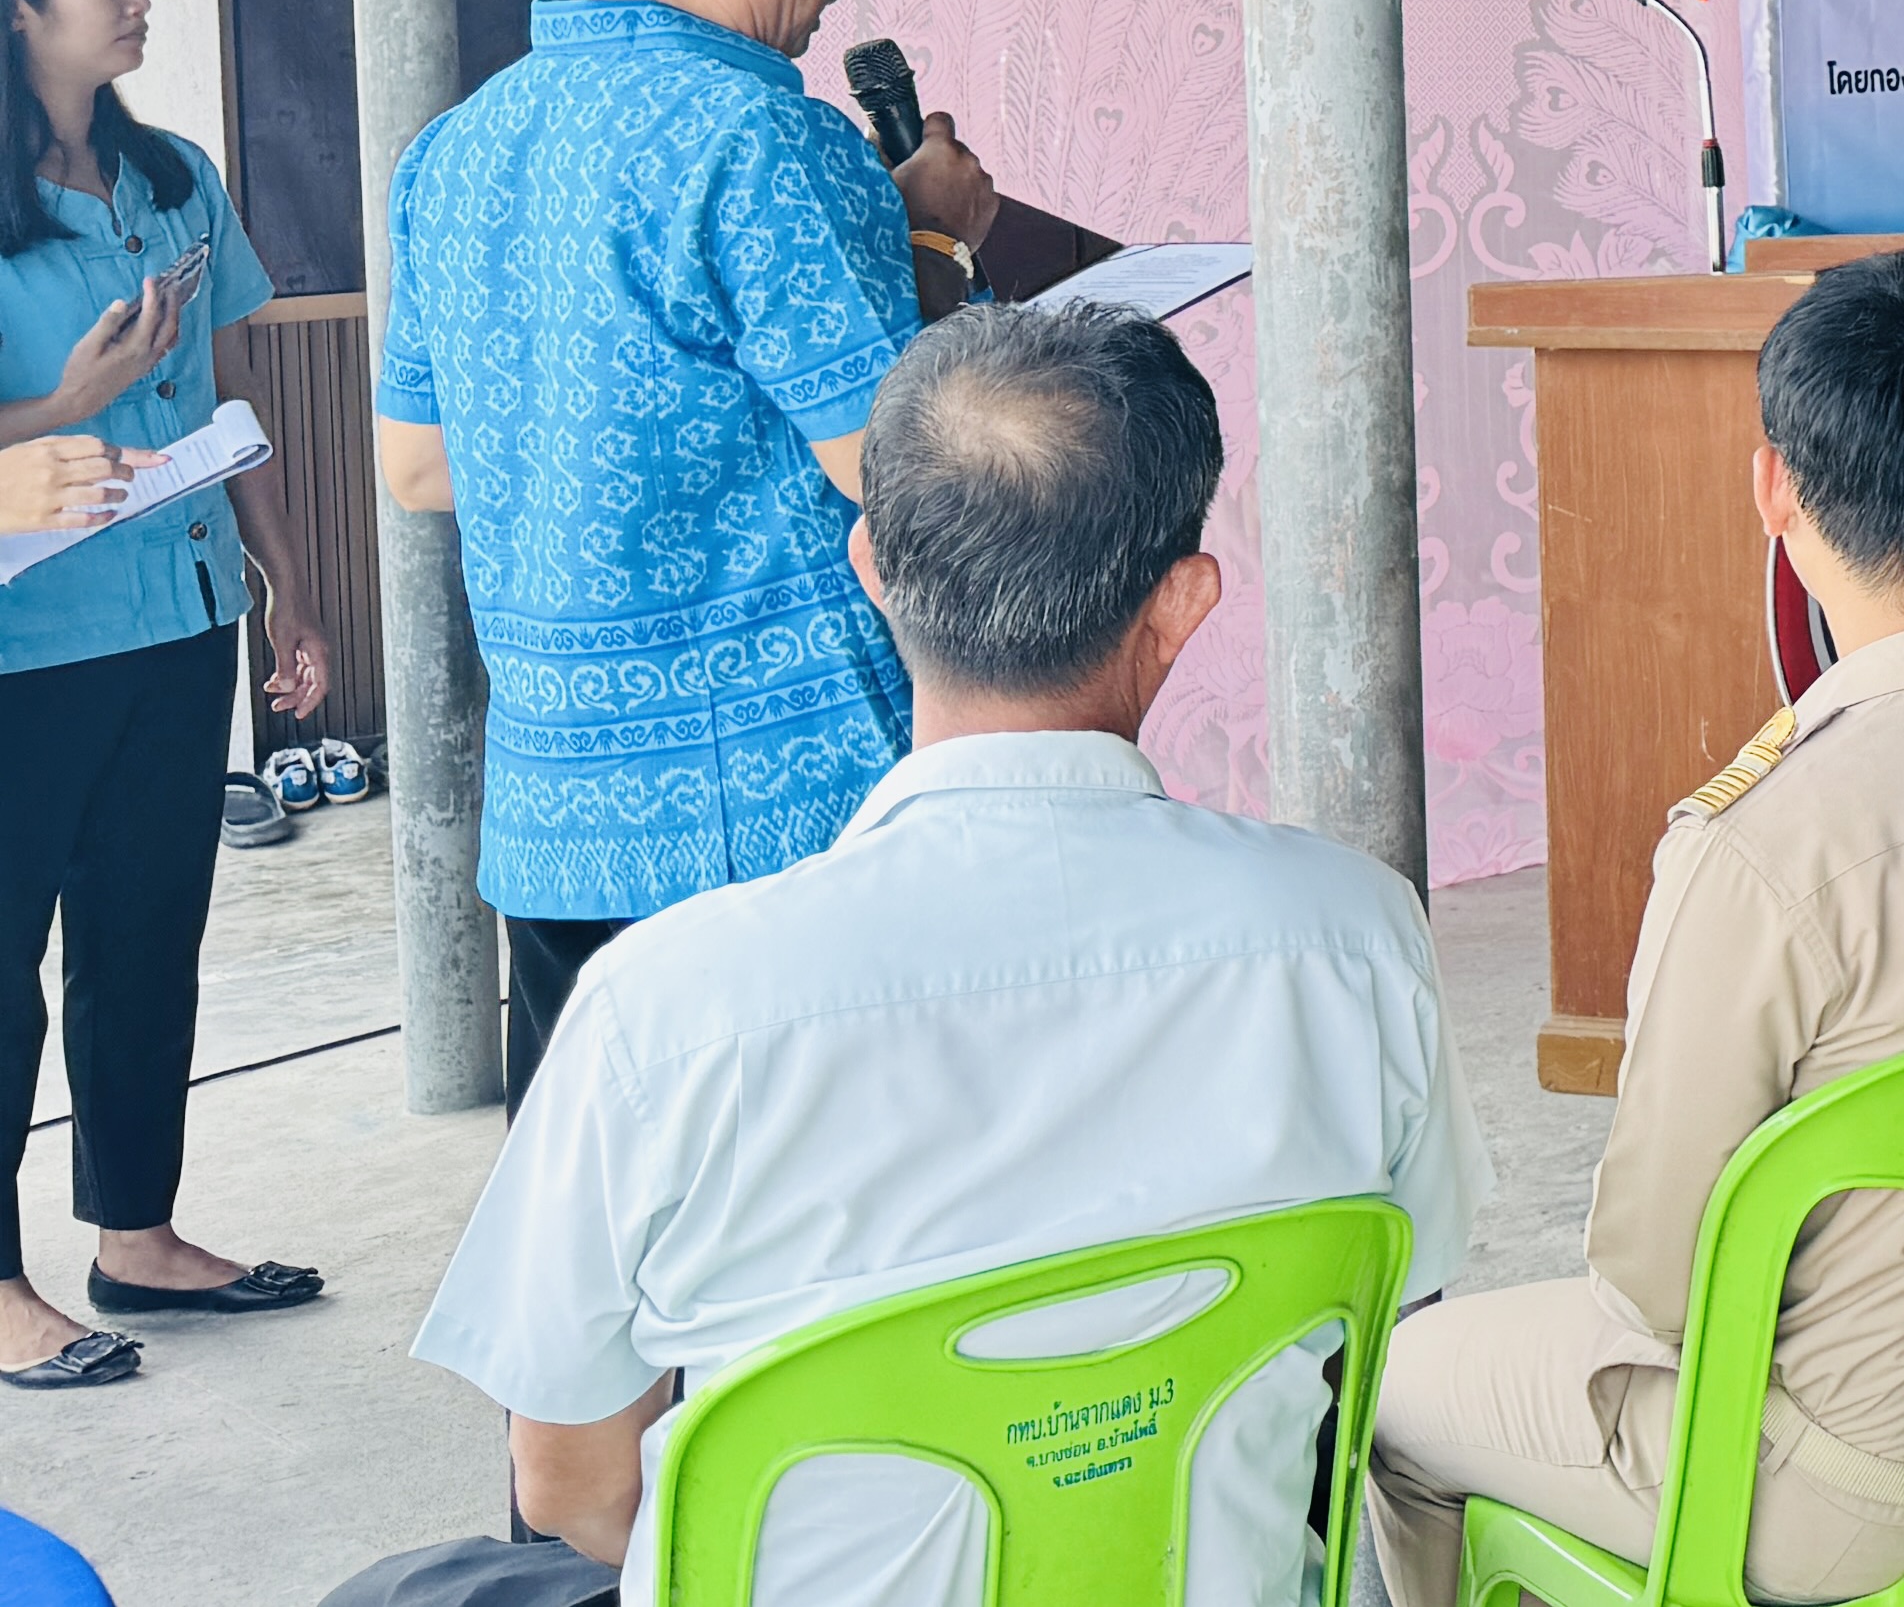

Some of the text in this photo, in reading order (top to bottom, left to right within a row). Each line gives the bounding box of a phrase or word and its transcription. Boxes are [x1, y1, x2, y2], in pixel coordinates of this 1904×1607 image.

[1006, 1377, 1175, 1445] กทบ.บ้านจากแดง ม.3
